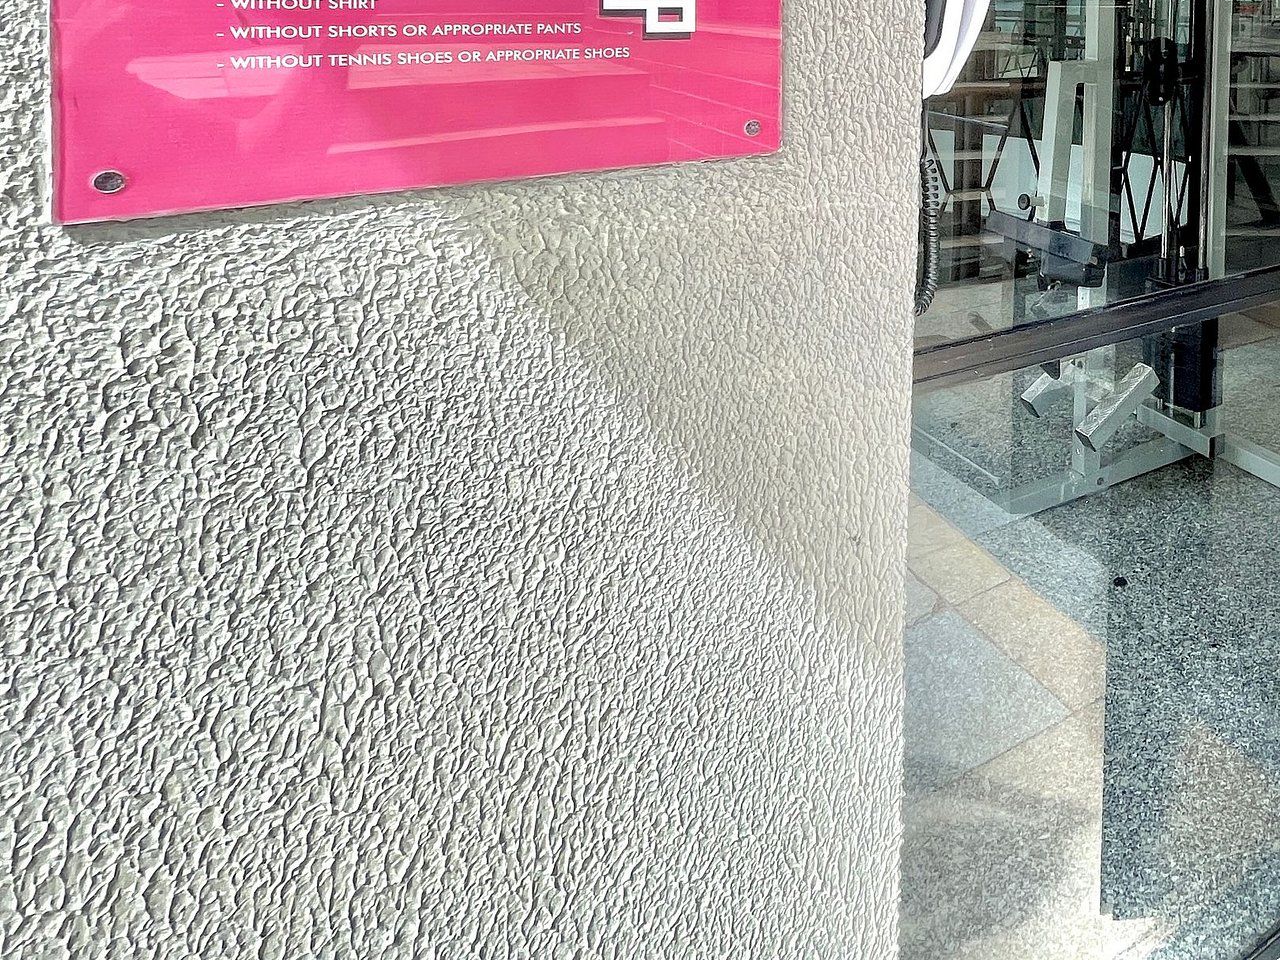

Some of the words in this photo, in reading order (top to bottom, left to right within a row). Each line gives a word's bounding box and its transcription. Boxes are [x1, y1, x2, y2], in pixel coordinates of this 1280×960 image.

[229, 25, 323, 40] WITHOUT
[328, 24, 398, 38] SHORTS
[402, 23, 428, 36] OR
[431, 22, 533, 36] APPROPRIATE
[537, 22, 582, 35] PANTS
[230, 55, 323, 69] WITHOUT
[328, 52, 391, 68] TENNIS
[397, 50, 452, 65] SHOES
[458, 49, 481, 62] OR
[486, 46, 581, 62] APPROPRIATE
[584, 46, 630, 59] SHOES
